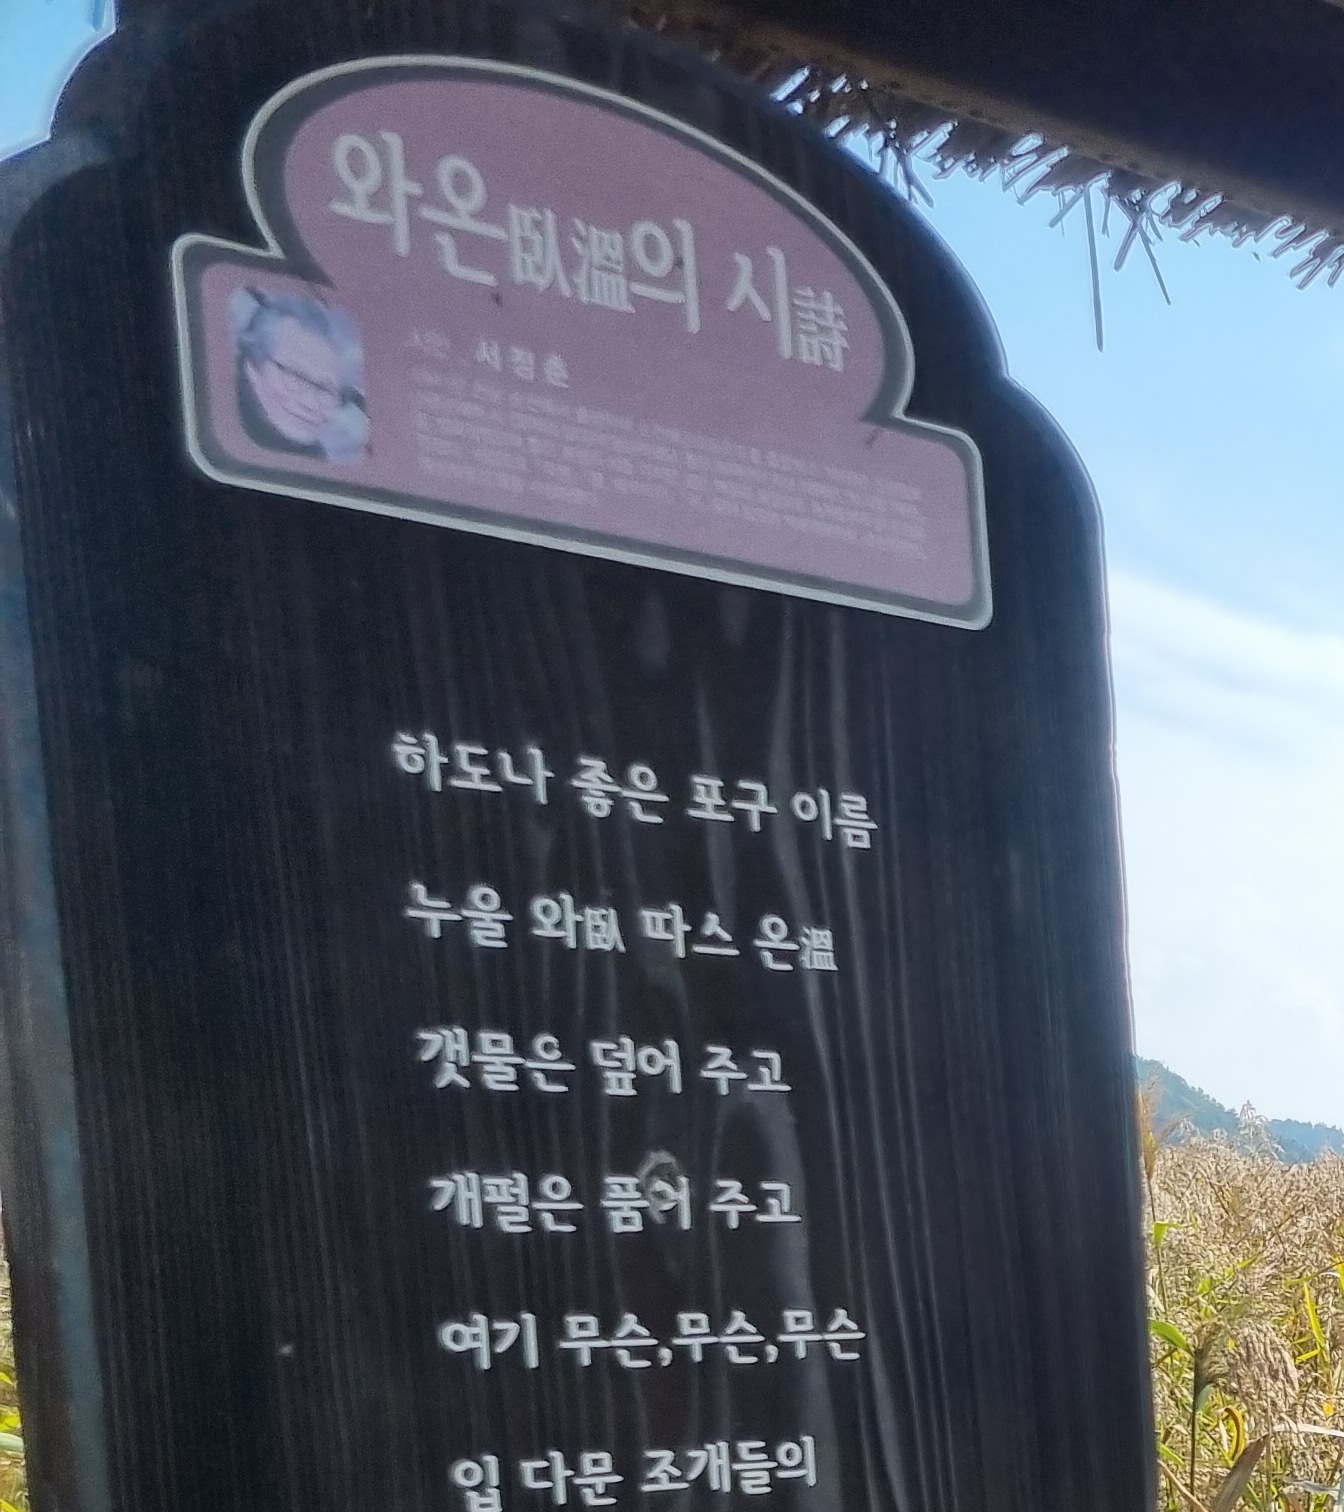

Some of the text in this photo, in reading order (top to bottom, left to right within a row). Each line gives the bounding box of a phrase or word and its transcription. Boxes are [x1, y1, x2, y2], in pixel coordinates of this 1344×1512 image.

[394, 731, 878, 849] 하도나 좋은 포구 이름
[406, 882, 514, 949] 누울
[640, 904, 740, 959] 따스
[415, 1026, 792, 1097] 갯물은 덮어 주고
[430, 1171, 803, 1234] 개펄은 품어 주고
[440, 1310, 540, 1371] 여기
[519, 1449, 625, 1507] 다문
[639, 1435, 818, 1495] 조개들의
